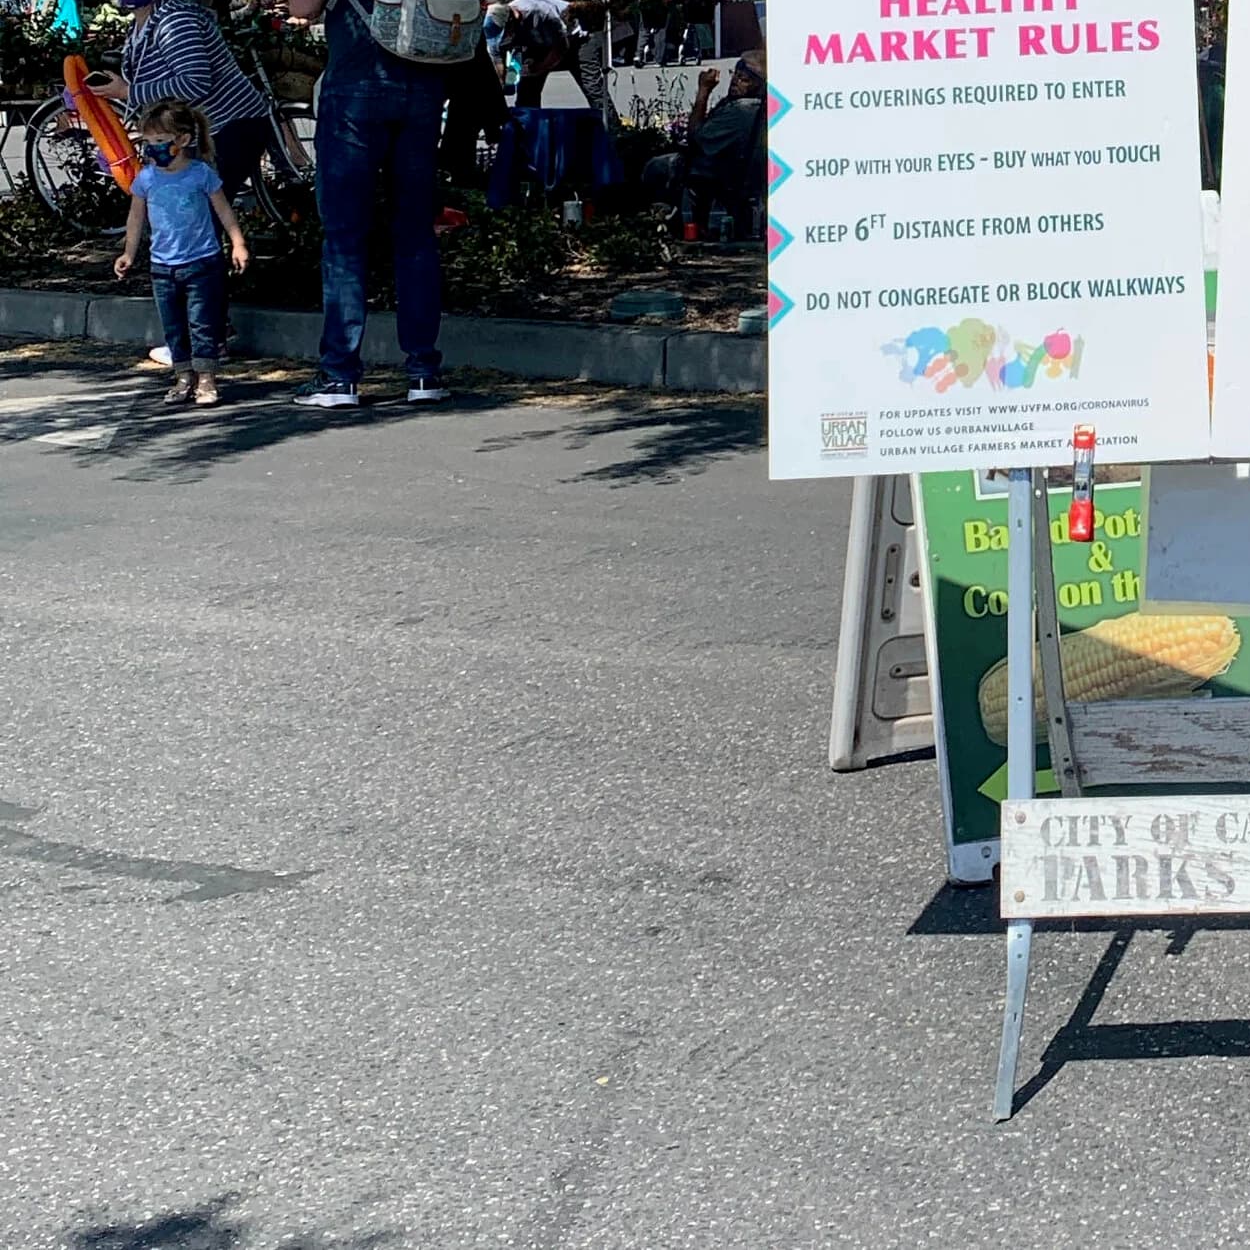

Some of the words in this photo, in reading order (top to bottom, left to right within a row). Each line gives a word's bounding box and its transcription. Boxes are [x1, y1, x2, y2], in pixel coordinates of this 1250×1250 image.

[805, 28, 995, 64] MARKET
[1019, 20, 1159, 55] RULES
[805, 92, 843, 110] FACE
[850, 88, 945, 108] COVERINGS
[953, 84, 1037, 105] REQUIRED
[1044, 83, 1065, 100] TO
[1073, 80, 1125, 98] ENTER
[806, 159, 849, 177] SHOP
[855, 160, 891, 174] WITH
[895, 158, 932, 173] YOUR
[938, 153, 975, 171] EYES
[994, 151, 1026, 168] BUY
[1031, 152, 1071, 167] WHAT
[1074, 150, 1101, 165] YOU
[1107, 145, 1160, 163] TOUCH
[806, 225, 847, 243] KEEP
[894, 219, 975, 239] DISTANCE
[982, 216, 1031, 235] FROM
[1038, 213, 1104, 233] OTHERS
[807, 293, 829, 310] DO
[838, 291, 871, 309] NOT
[879, 285, 989, 307] CONGREGATE
[997, 284, 1019, 301] OR
[1027, 281, 1081, 300] BLOCK
[1088, 276, 1184, 297] WALKWAYS
[880, 411, 900, 419] FOR
[904, 408, 951, 418] UPDATES
[955, 406, 981, 416] VISIT
[988, 398, 1149, 414] WWW.UVFM.ORG/CORONAVIRUS
[821, 419, 867, 435] URBAN
[880, 428, 924, 438] FOLLOW
[928, 427, 941, 436] US
[945, 422, 1034, 434] @URBANVILLAGE
[880, 447, 916, 456] URBAN
[920, 444, 964, 454] VILLAGE
[968, 442, 1016, 452] FARMERS
[1020, 439, 1062, 449] MARKET
[1066, 435, 1138, 448] ACIATION
[964, 511, 1071, 553] Bad
[1088, 541, 1114, 572] &
[1059, 581, 1103, 608] on
[1111, 570, 1140, 603] th
[1040, 814, 1132, 848] CITY
[1150, 813, 1197, 846] OF
[1040, 850, 1236, 903] PARKS
